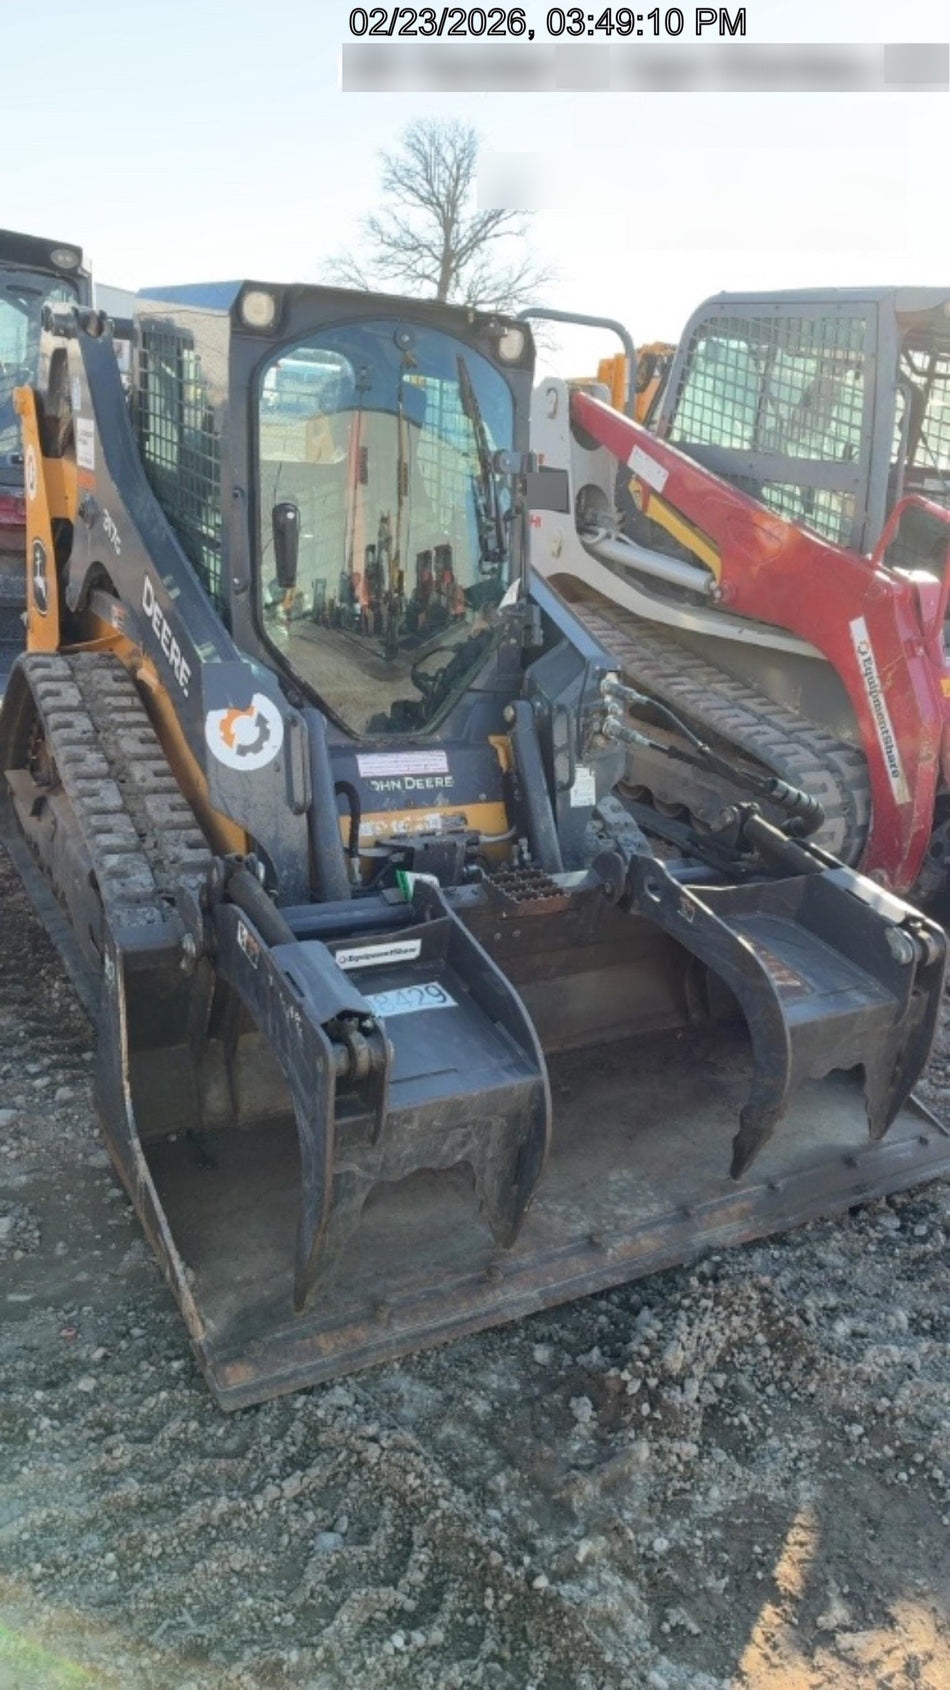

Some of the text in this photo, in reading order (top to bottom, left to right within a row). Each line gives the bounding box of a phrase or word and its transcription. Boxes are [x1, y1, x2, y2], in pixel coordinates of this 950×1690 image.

[142, 575, 192, 698] DEERE
[862, 657, 900, 779] EquipmentShare
[368, 775, 454, 792] OHN DEERE
